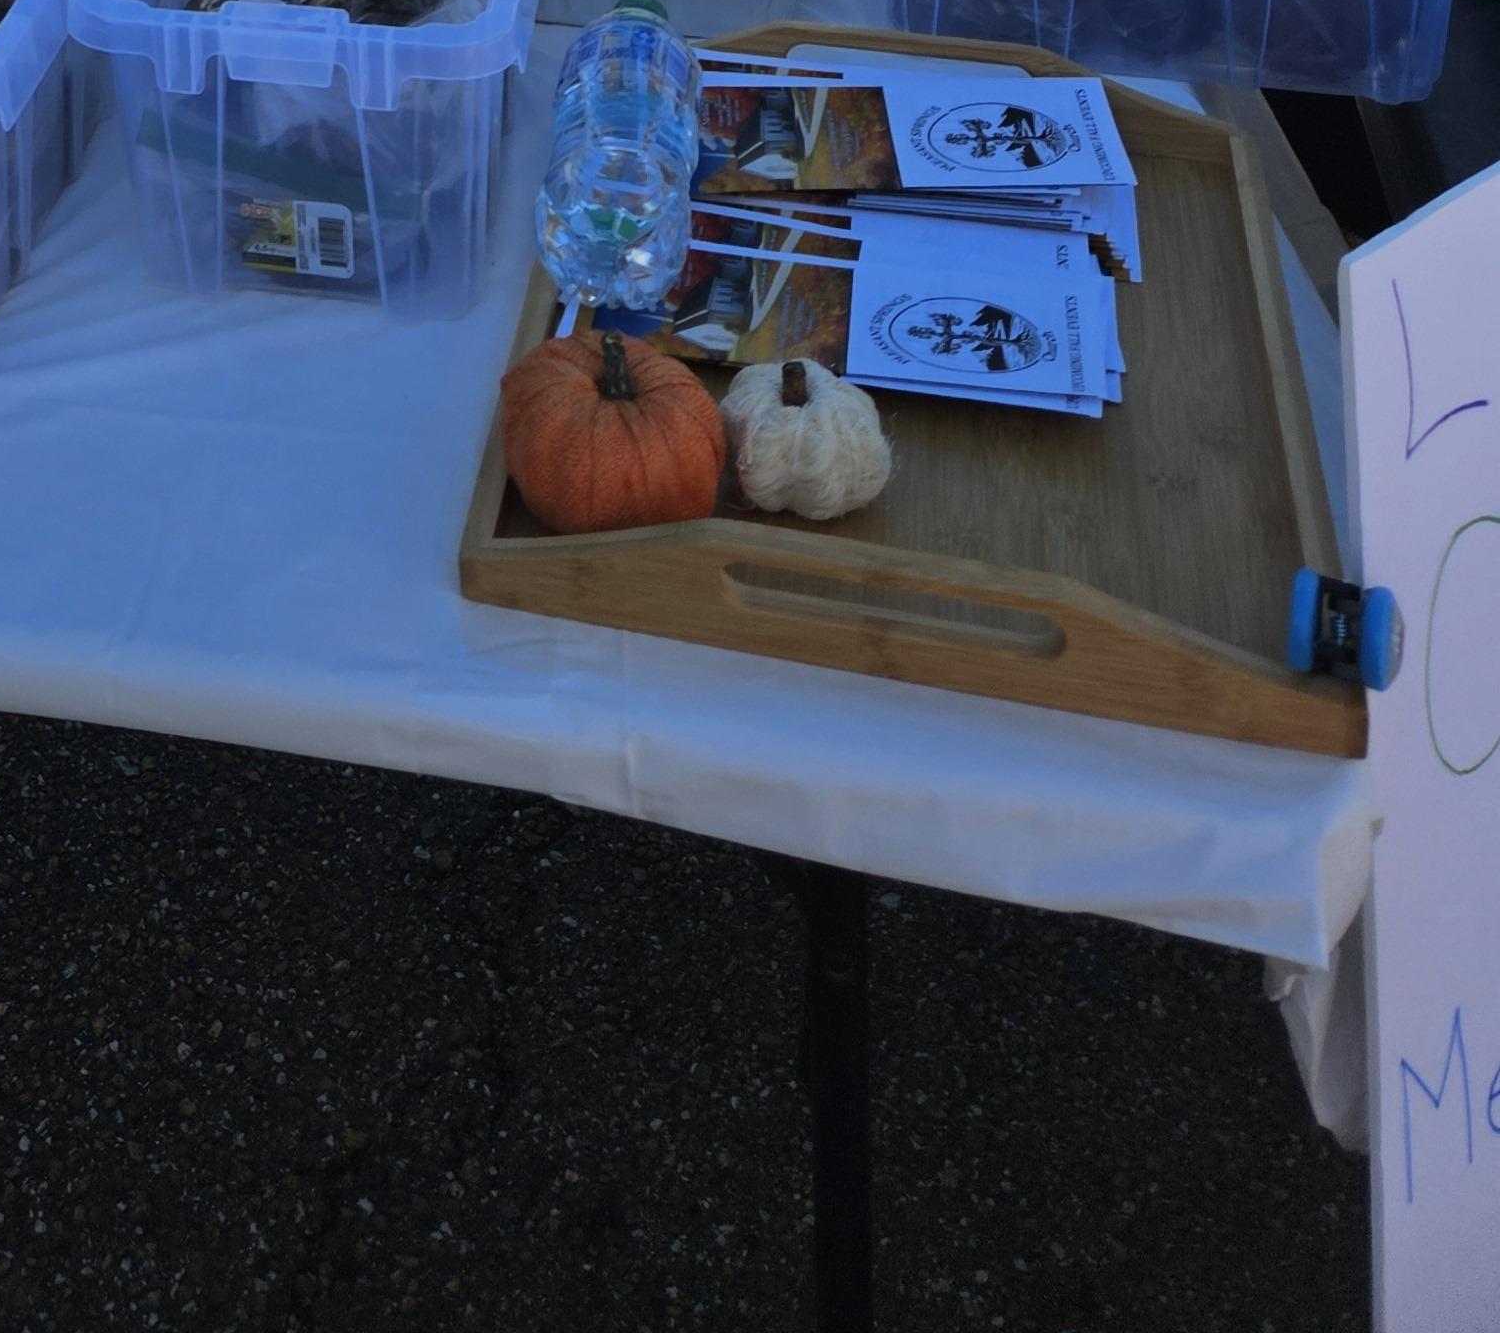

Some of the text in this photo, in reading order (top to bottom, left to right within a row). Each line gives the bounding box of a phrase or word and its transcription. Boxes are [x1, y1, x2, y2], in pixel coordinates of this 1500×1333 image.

[1064, 294, 1081, 331] EVENTS
[1067, 332, 1082, 352] FALL
[1068, 352, 1086, 394] UPCOMING
[1400, 1004, 1500, 1205] M
